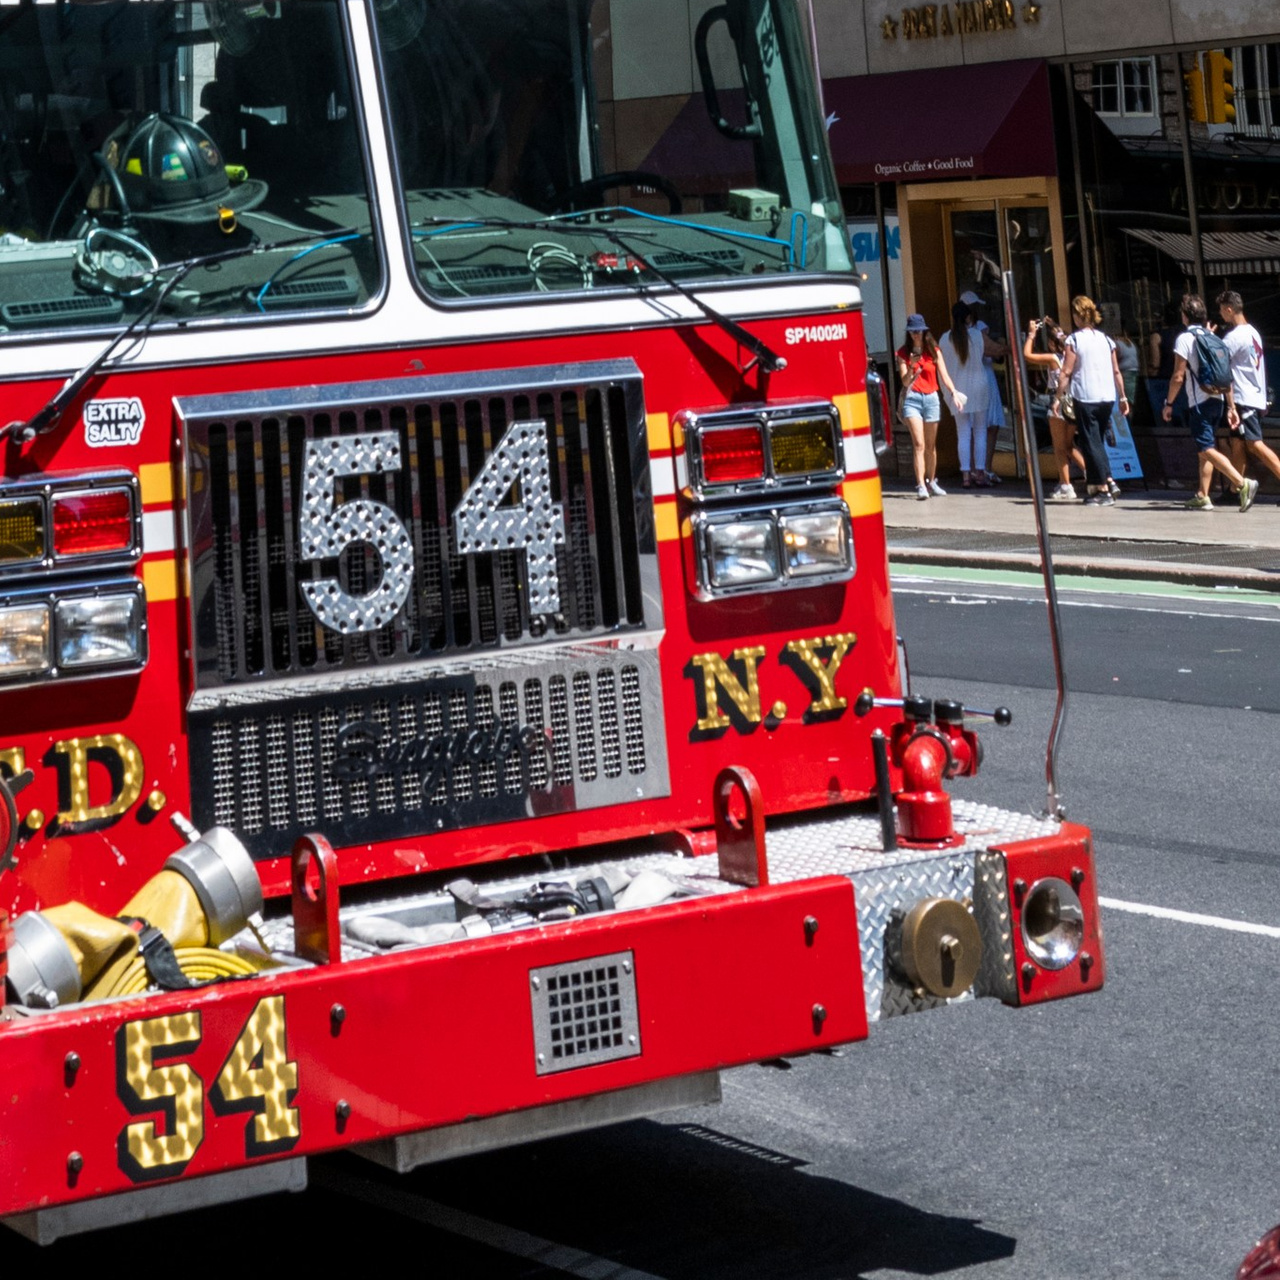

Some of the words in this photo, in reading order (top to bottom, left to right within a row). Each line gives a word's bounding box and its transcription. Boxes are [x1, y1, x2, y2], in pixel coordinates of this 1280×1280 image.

[874, 163, 902, 176] Organic
[903, 160, 926, 173] Coffee
[933, 157, 954, 170] Good
[955, 156, 974, 169] Food
[785, 323, 848, 345] SP14002H
[87, 401, 141, 422] EXTRA
[89, 421, 140, 442] SALTY
[299, 419, 567, 636] 54
[123, 994, 300, 1169] 54
